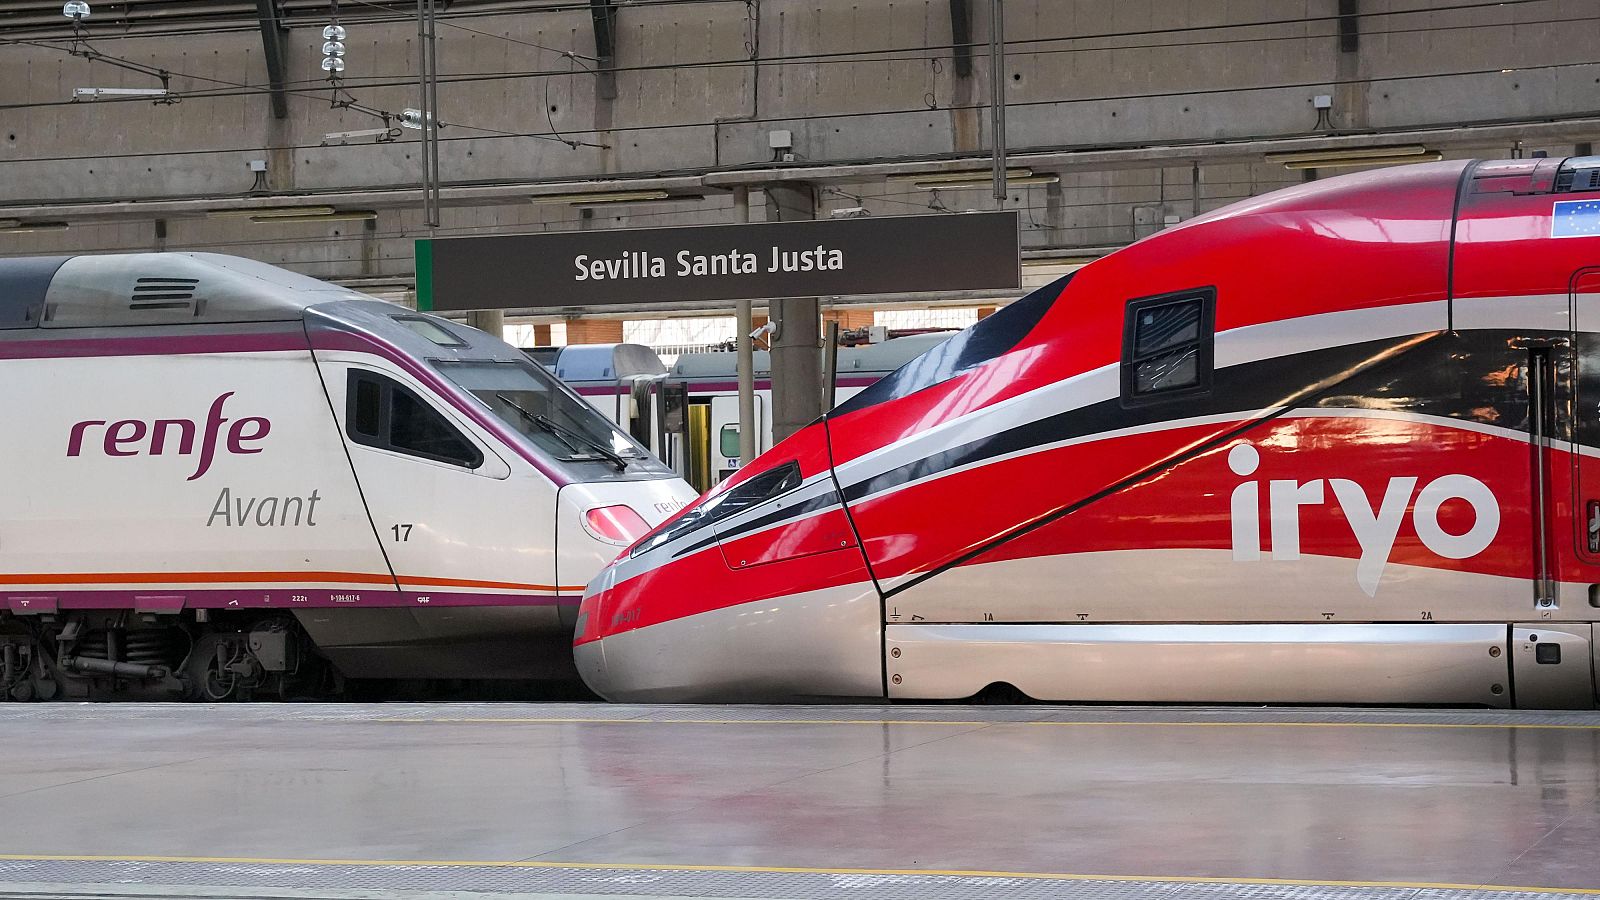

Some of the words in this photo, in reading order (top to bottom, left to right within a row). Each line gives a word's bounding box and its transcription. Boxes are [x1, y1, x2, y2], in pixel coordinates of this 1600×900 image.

[574, 250, 666, 281] Sevilla
[676, 248, 758, 277] Santa
[767, 244, 844, 273] Justa
[66, 391, 271, 481] renfe
[207, 487, 321, 527] Avant
[1228, 443, 1501, 598] iryo
[391, 523, 413, 542] 17
[983, 612, 994, 622] 1A
[1421, 611, 1433, 621] 2A
